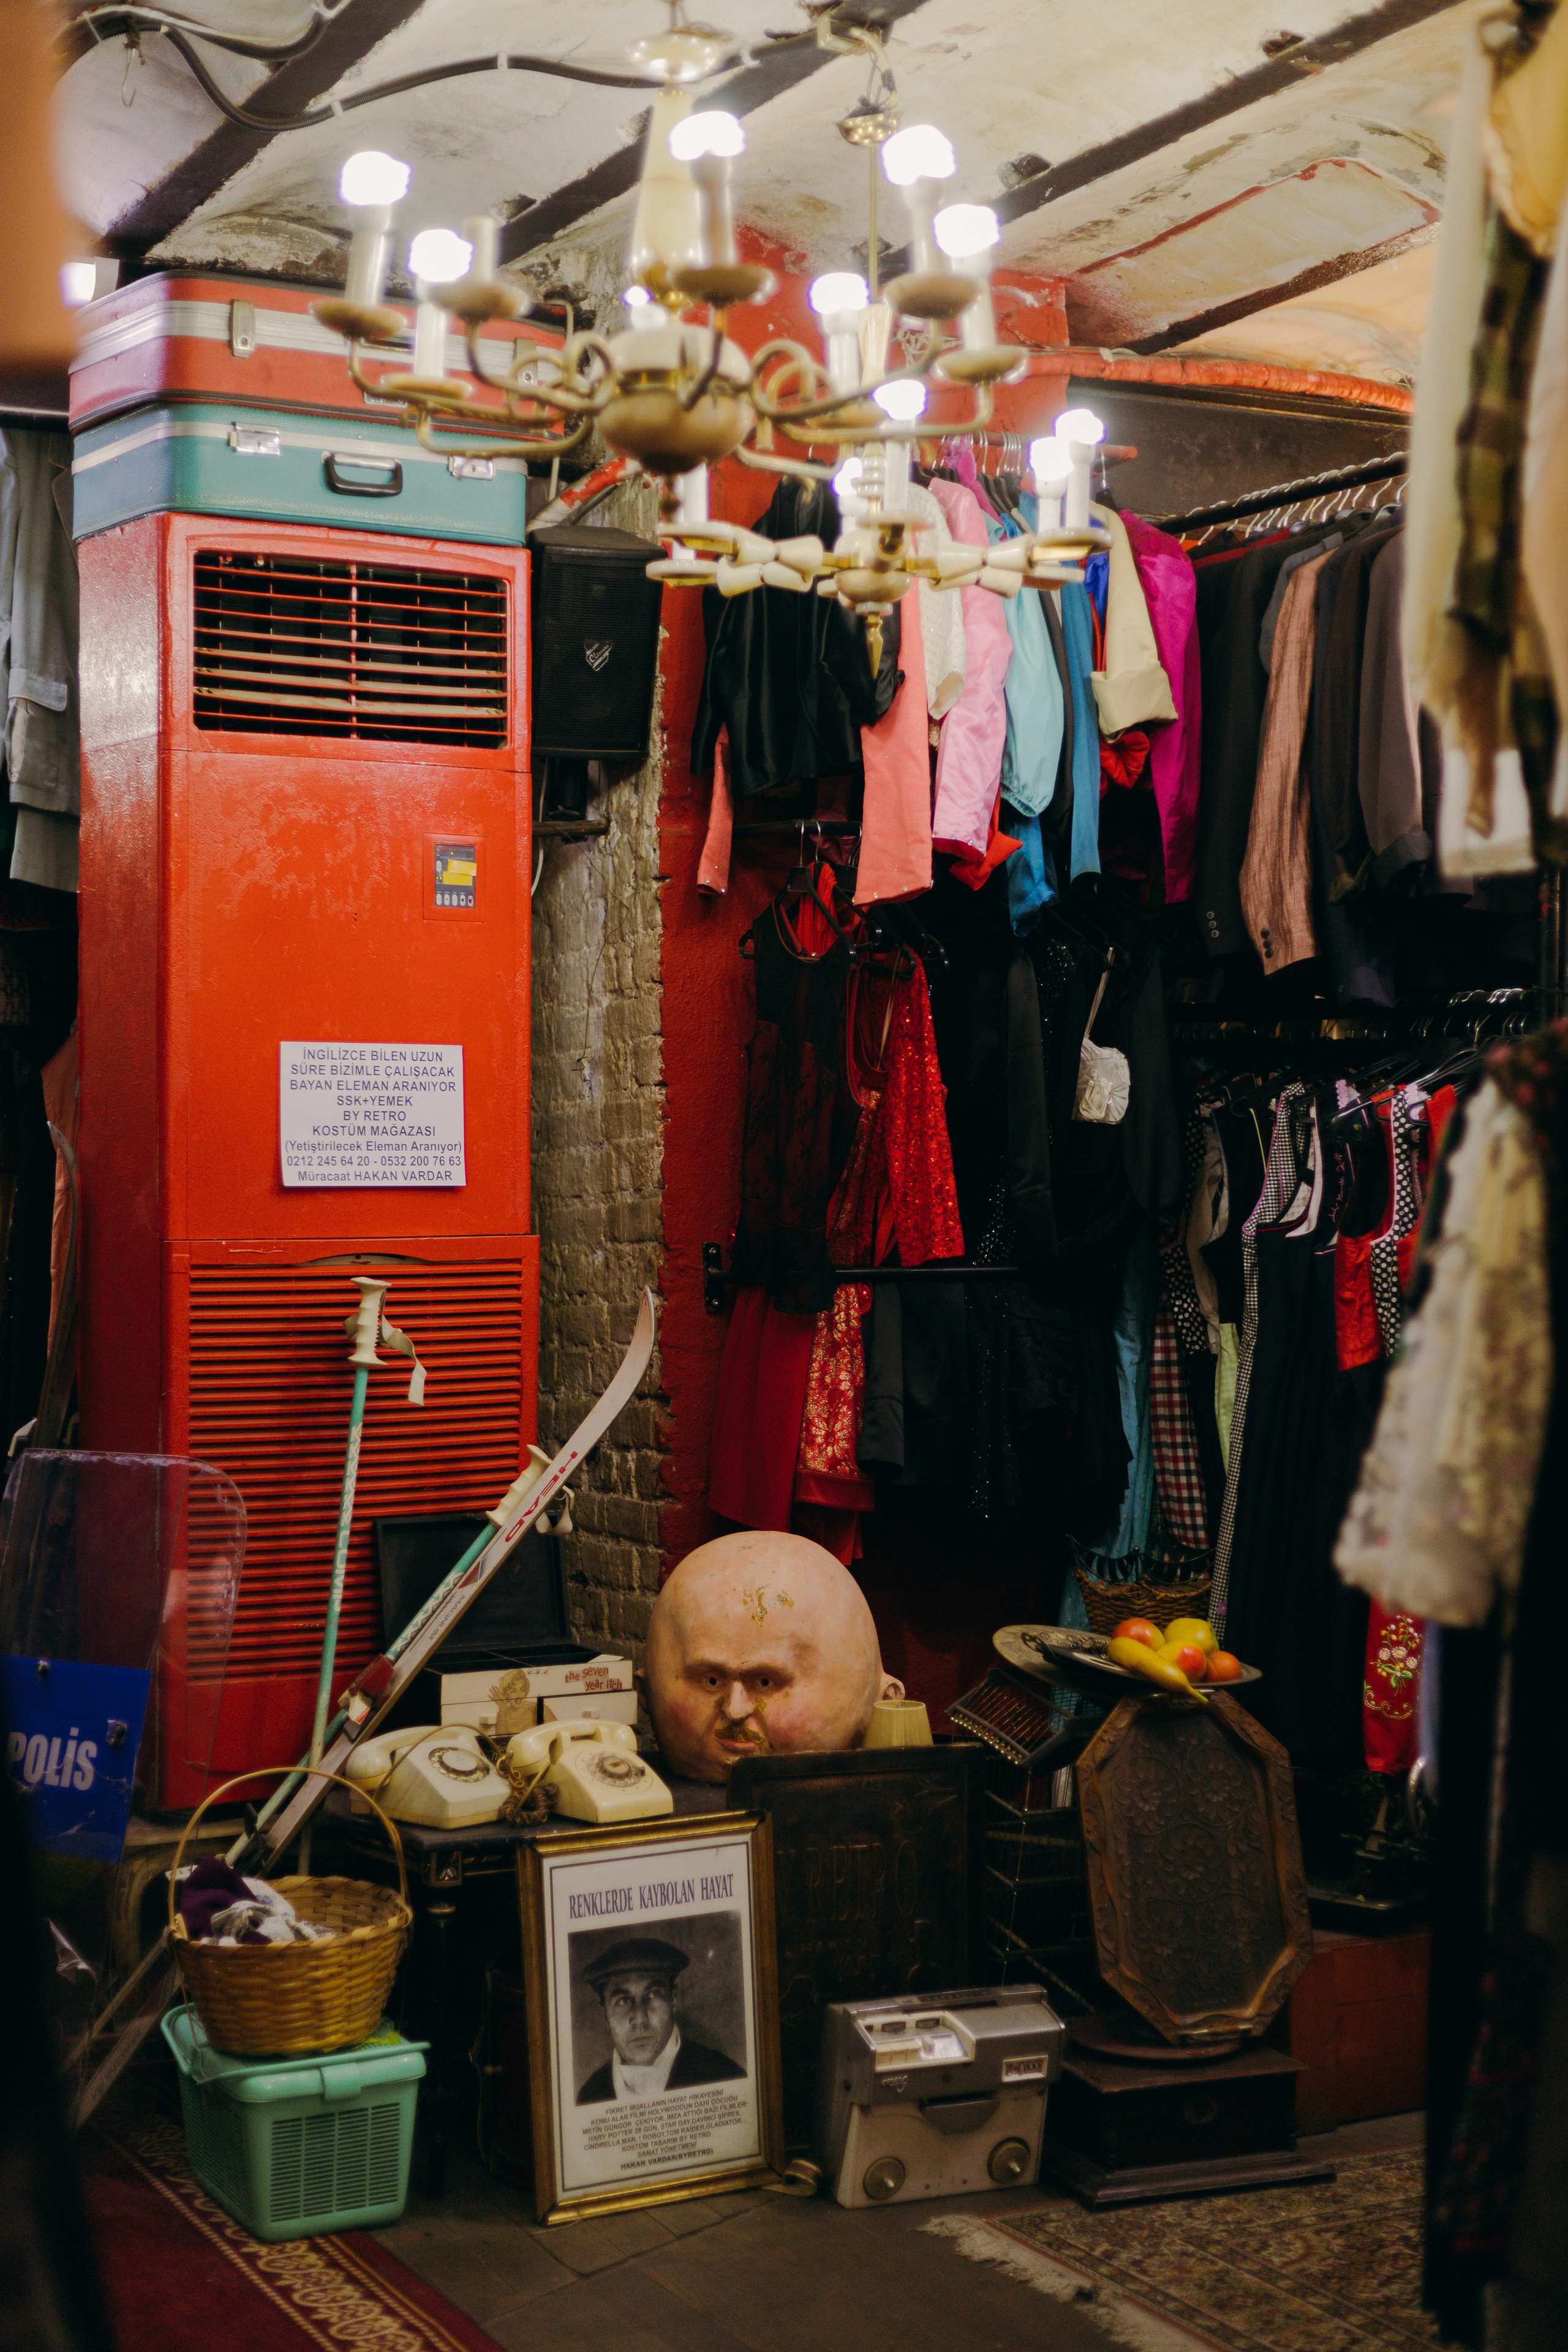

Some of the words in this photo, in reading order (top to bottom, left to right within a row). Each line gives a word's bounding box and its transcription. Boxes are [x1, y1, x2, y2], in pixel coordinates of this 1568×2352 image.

[303, 1047, 367, 1060] İNGİLİZCE
[371, 1048, 407, 1061] BİLEN
[412, 1052, 443, 1061] UZUN
[291, 1062, 326, 1075] SÜRE
[331, 1063, 380, 1076] BİZİMLE
[385, 1066, 454, 1079] ÇALIŞACAK
[290, 1080, 332, 1090] BAYAN
[337, 1080, 388, 1091] ELEMAN
[393, 1081, 456, 1091] ARANIYOR
[337, 1096, 413, 1106] SSK+YEMEK
[344, 1111, 360, 1121] BY
[364, 1111, 406, 1121] RETRO
[313, 1124, 366, 1136] KOSTÜM
[371, 1123, 435, 1136] MAĞAZASI
[285, 1140, 362, 1153] (Yetiştirilecek
[366, 1141, 407, 1151] Eleman
[411, 1141, 461, 1153] Aranıyor)
[287, 1156, 313, 1166] 0212
[317, 1156, 337, 1166] 245
[341, 1156, 353, 1166] 64
[358, 1156, 369, 1166] 20
[381, 1156, 406, 1166] 0532
[410, 1156, 429, 1166] 200
[433, 1156, 445, 1166] 76
[449, 1156, 461, 1166] 63
[298, 1171, 350, 1181] Müracaat
[354, 1171, 398, 1180] HAKAN
[402, 1171, 452, 1181] VARDAR
[505, 1450, 579, 1543] HEAD
[429, 1594, 466, 1641] MAGNUM
[565, 1671, 579, 1683] the
[582, 1667, 608, 1678] seven
[586, 1679, 603, 1692] year
[606, 1678, 622, 1691] itch
[569, 1887, 633, 1920] RENKLERDE
[639, 1879, 695, 1910] KAYBOLAN
[701, 1874, 734, 1901] HAYAT
[606, 2106, 628, 2115] FİKRET
[689, 2089, 723, 2100] HİKAYESİNİ
[648, 2103, 693, 2116] HOLYWOODUN
[711, 2095, 737, 2105] ÇOCUĞU
[605, 2121, 631, 2131] GÜNGÖR
[608, 2130, 632, 2139] POTTER
[661, 2121, 676, 2130] STAR
[622, 2142, 649, 2152] KOSTÜM
[651, 2136, 678, 2147] TASARIM
[690, 2132, 710, 2140] RETRO
[660, 2141, 697, 2153] YÖNETMENİ
[621, 2160, 646, 2169] HAKAN
